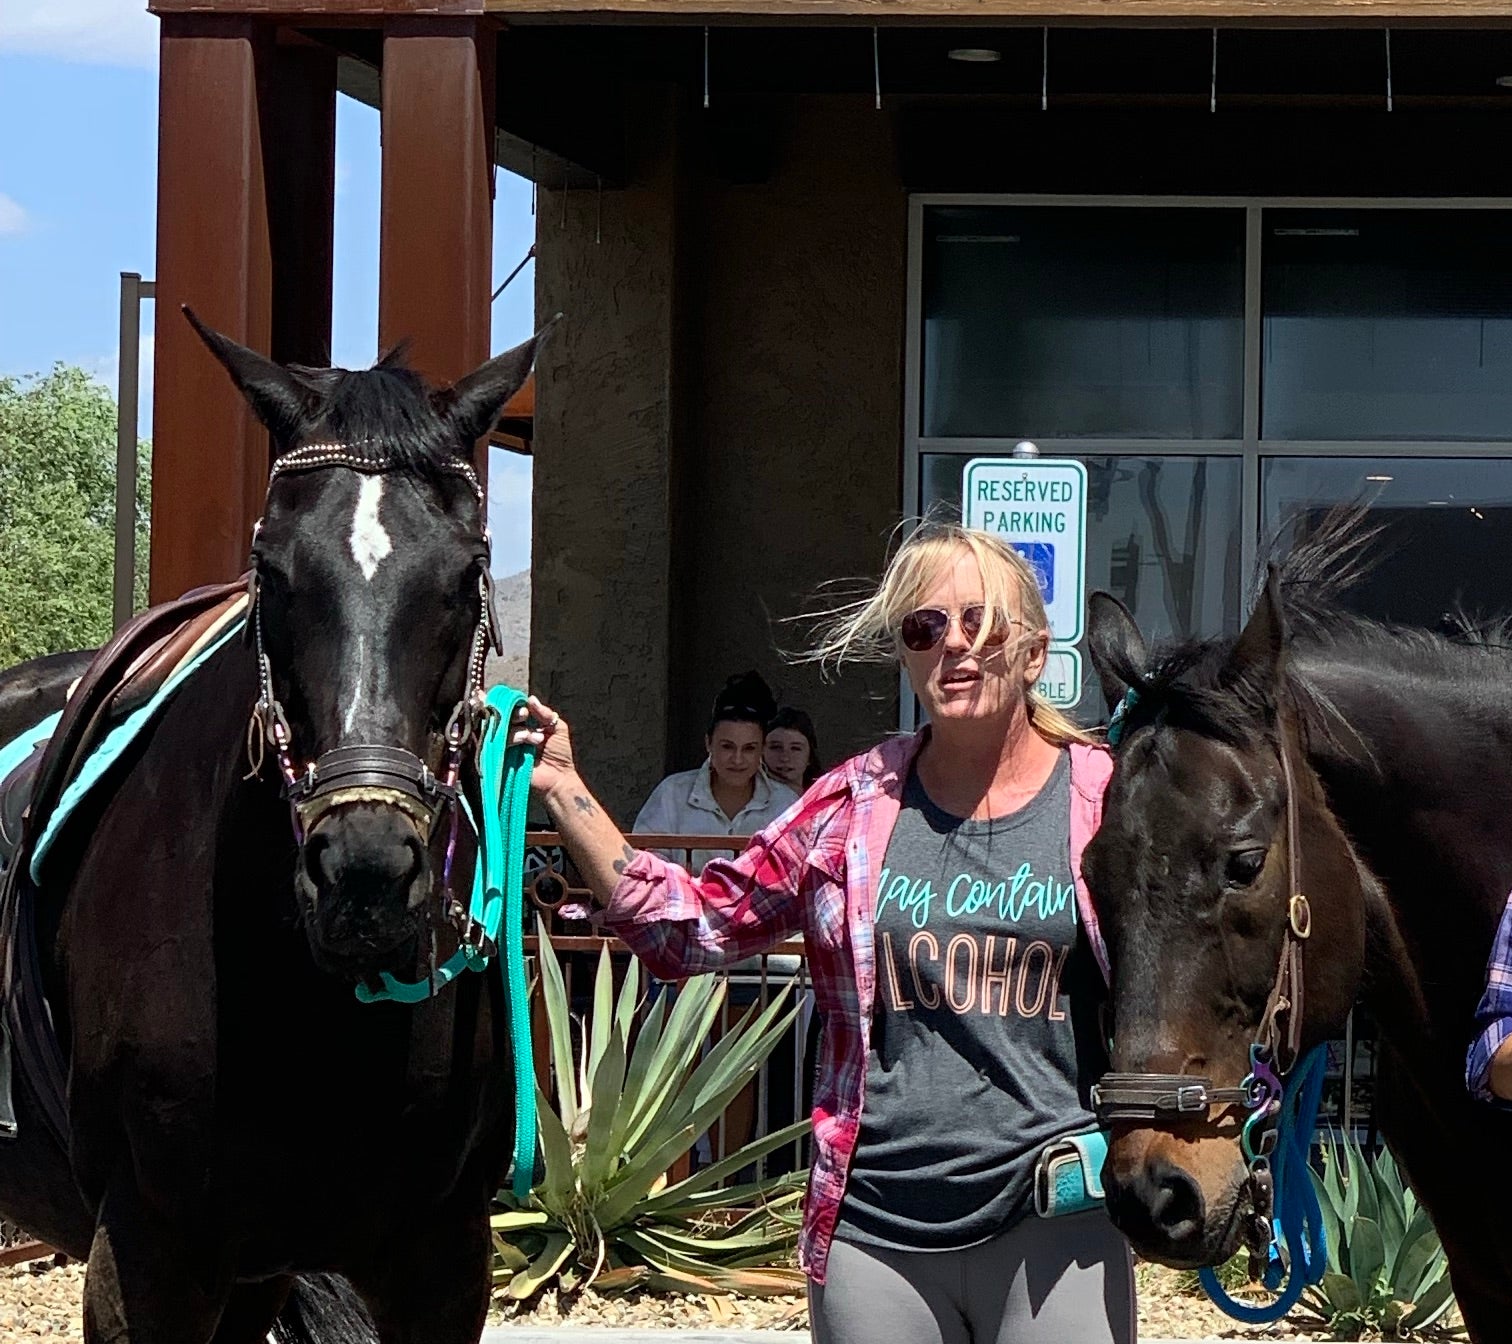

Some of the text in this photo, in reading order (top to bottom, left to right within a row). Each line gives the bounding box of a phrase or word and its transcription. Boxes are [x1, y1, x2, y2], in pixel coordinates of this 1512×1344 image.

[977, 479, 1073, 503] RESERVED
[983, 510, 1066, 533] PARKING
[882, 930, 1070, 1021] LCOHOL
